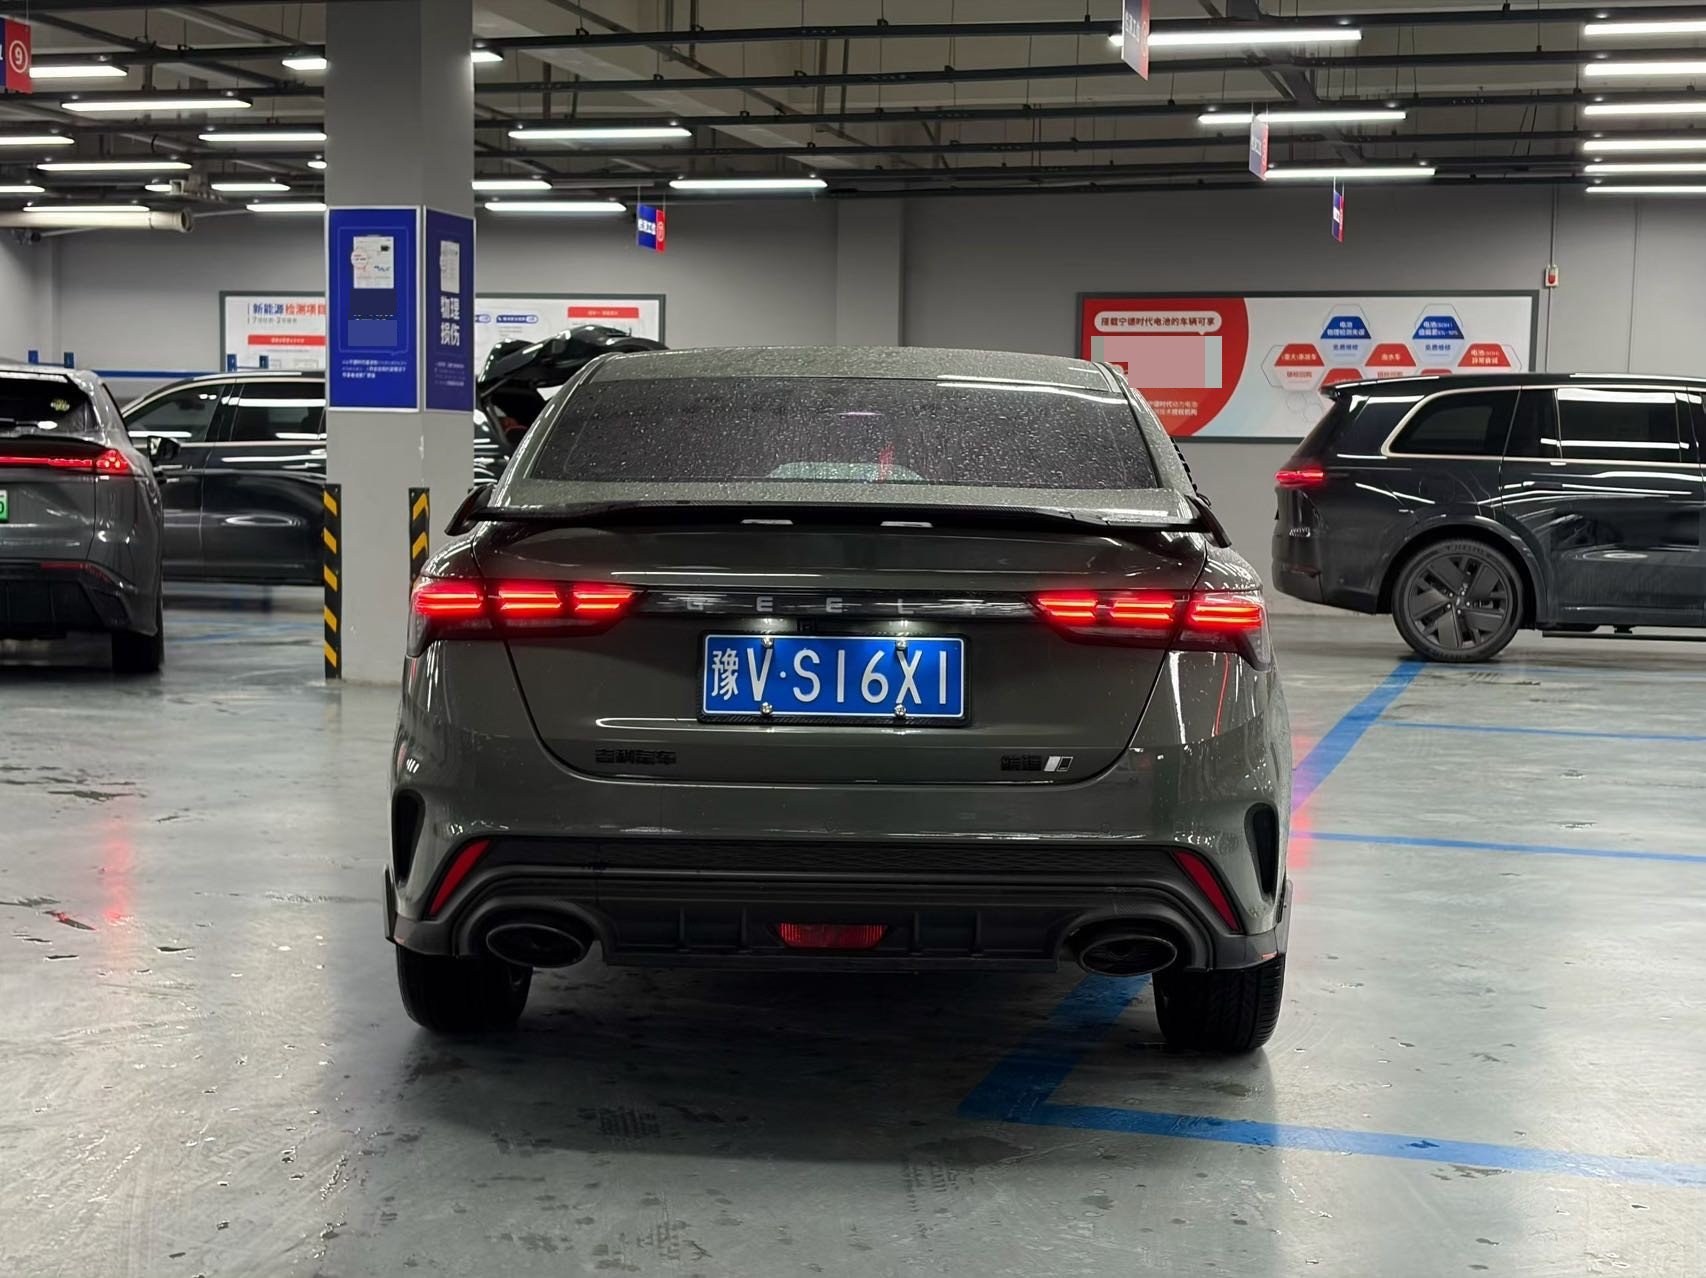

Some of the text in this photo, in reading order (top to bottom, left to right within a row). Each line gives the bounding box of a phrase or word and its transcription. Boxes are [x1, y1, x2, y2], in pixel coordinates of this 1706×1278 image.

[15, 46, 23, 65] 9
[440, 296, 460, 319] 物理
[1101, 316, 1215, 327] 搭载宁德时代电池的车辆可享
[440, 322, 460, 346] 损伤
